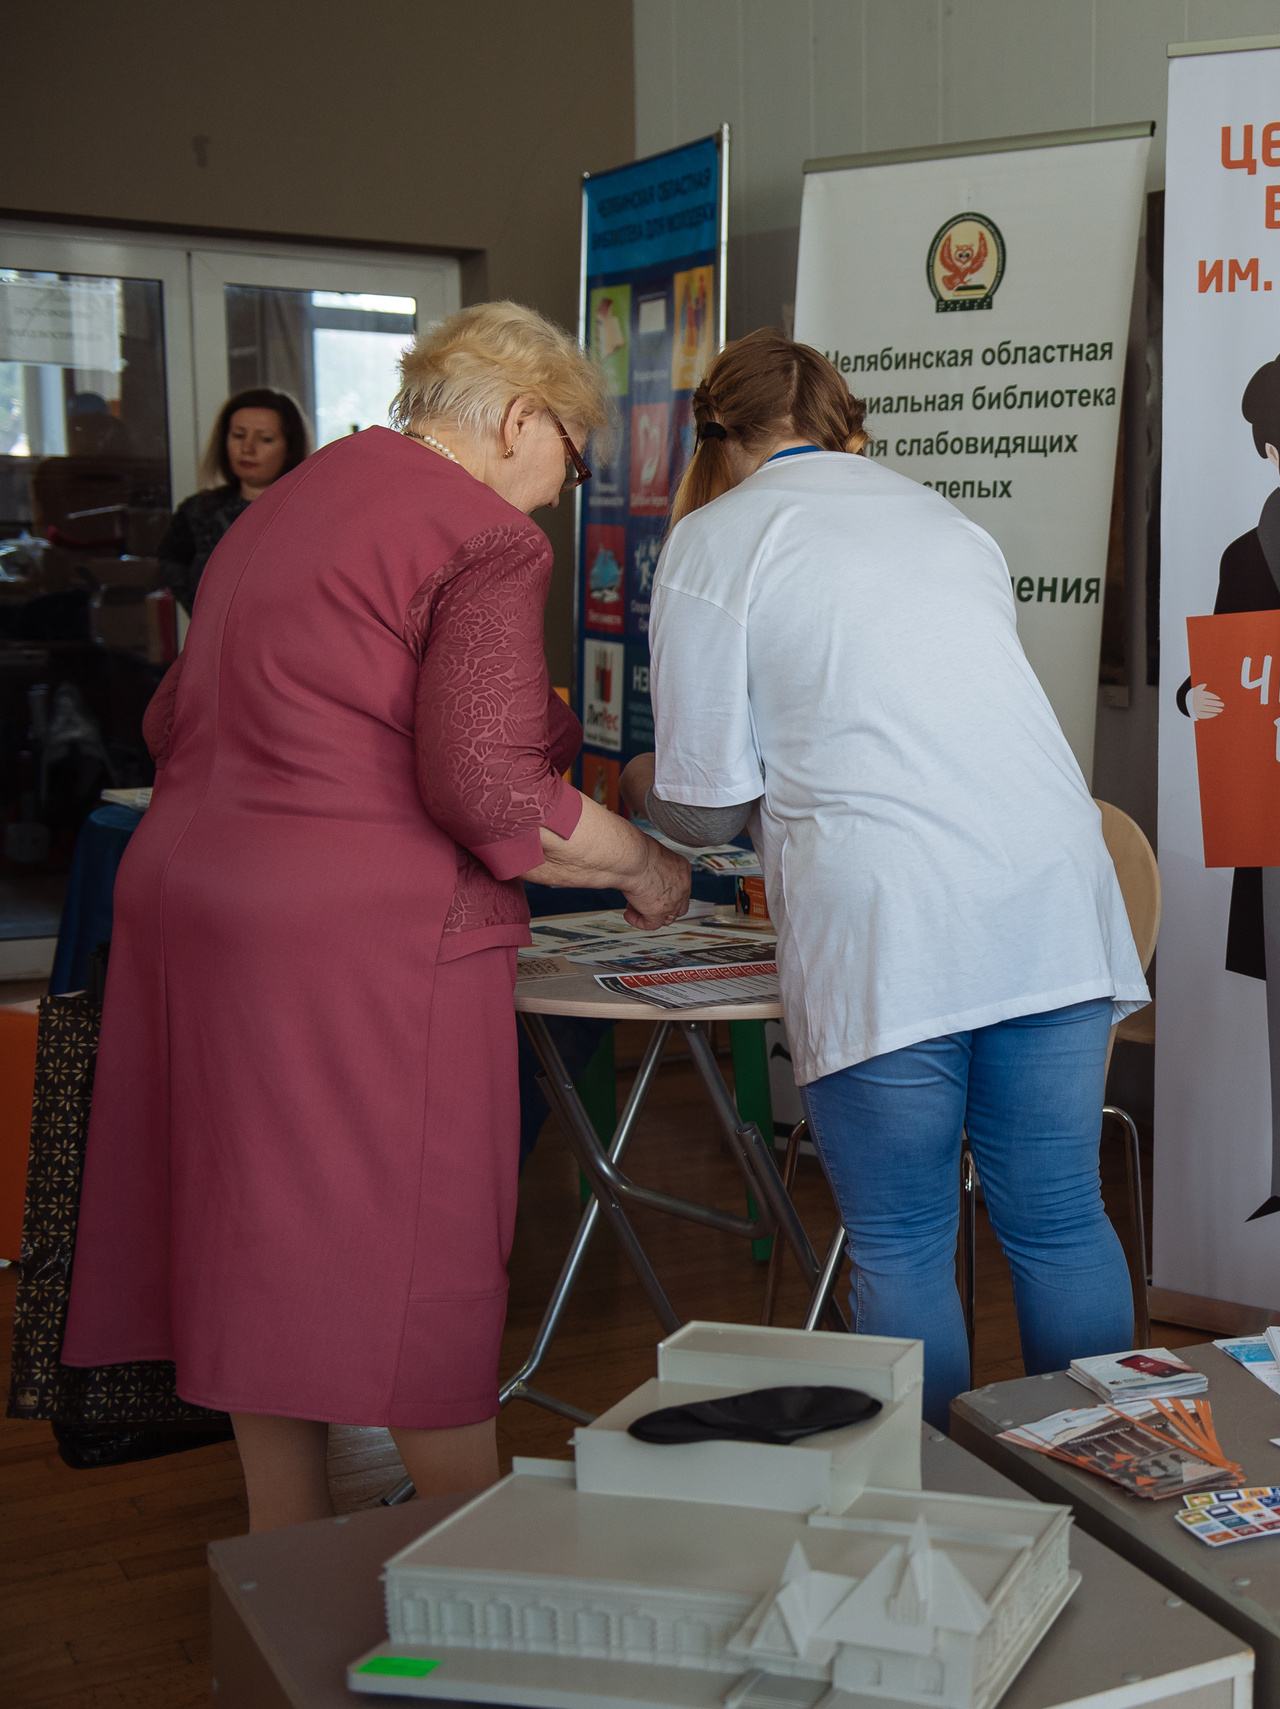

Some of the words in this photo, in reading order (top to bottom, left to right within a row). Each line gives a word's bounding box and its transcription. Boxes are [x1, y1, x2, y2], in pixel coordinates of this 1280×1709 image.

[1198, 257, 1272, 293] им.
[826, 346, 973, 373] Челябинская
[981, 340, 1113, 366] областная
[863, 391, 964, 416] иальная
[972, 385, 1116, 410] библиотека
[895, 431, 1078, 458] слабовидящих
[1011, 575, 1100, 604] ения
